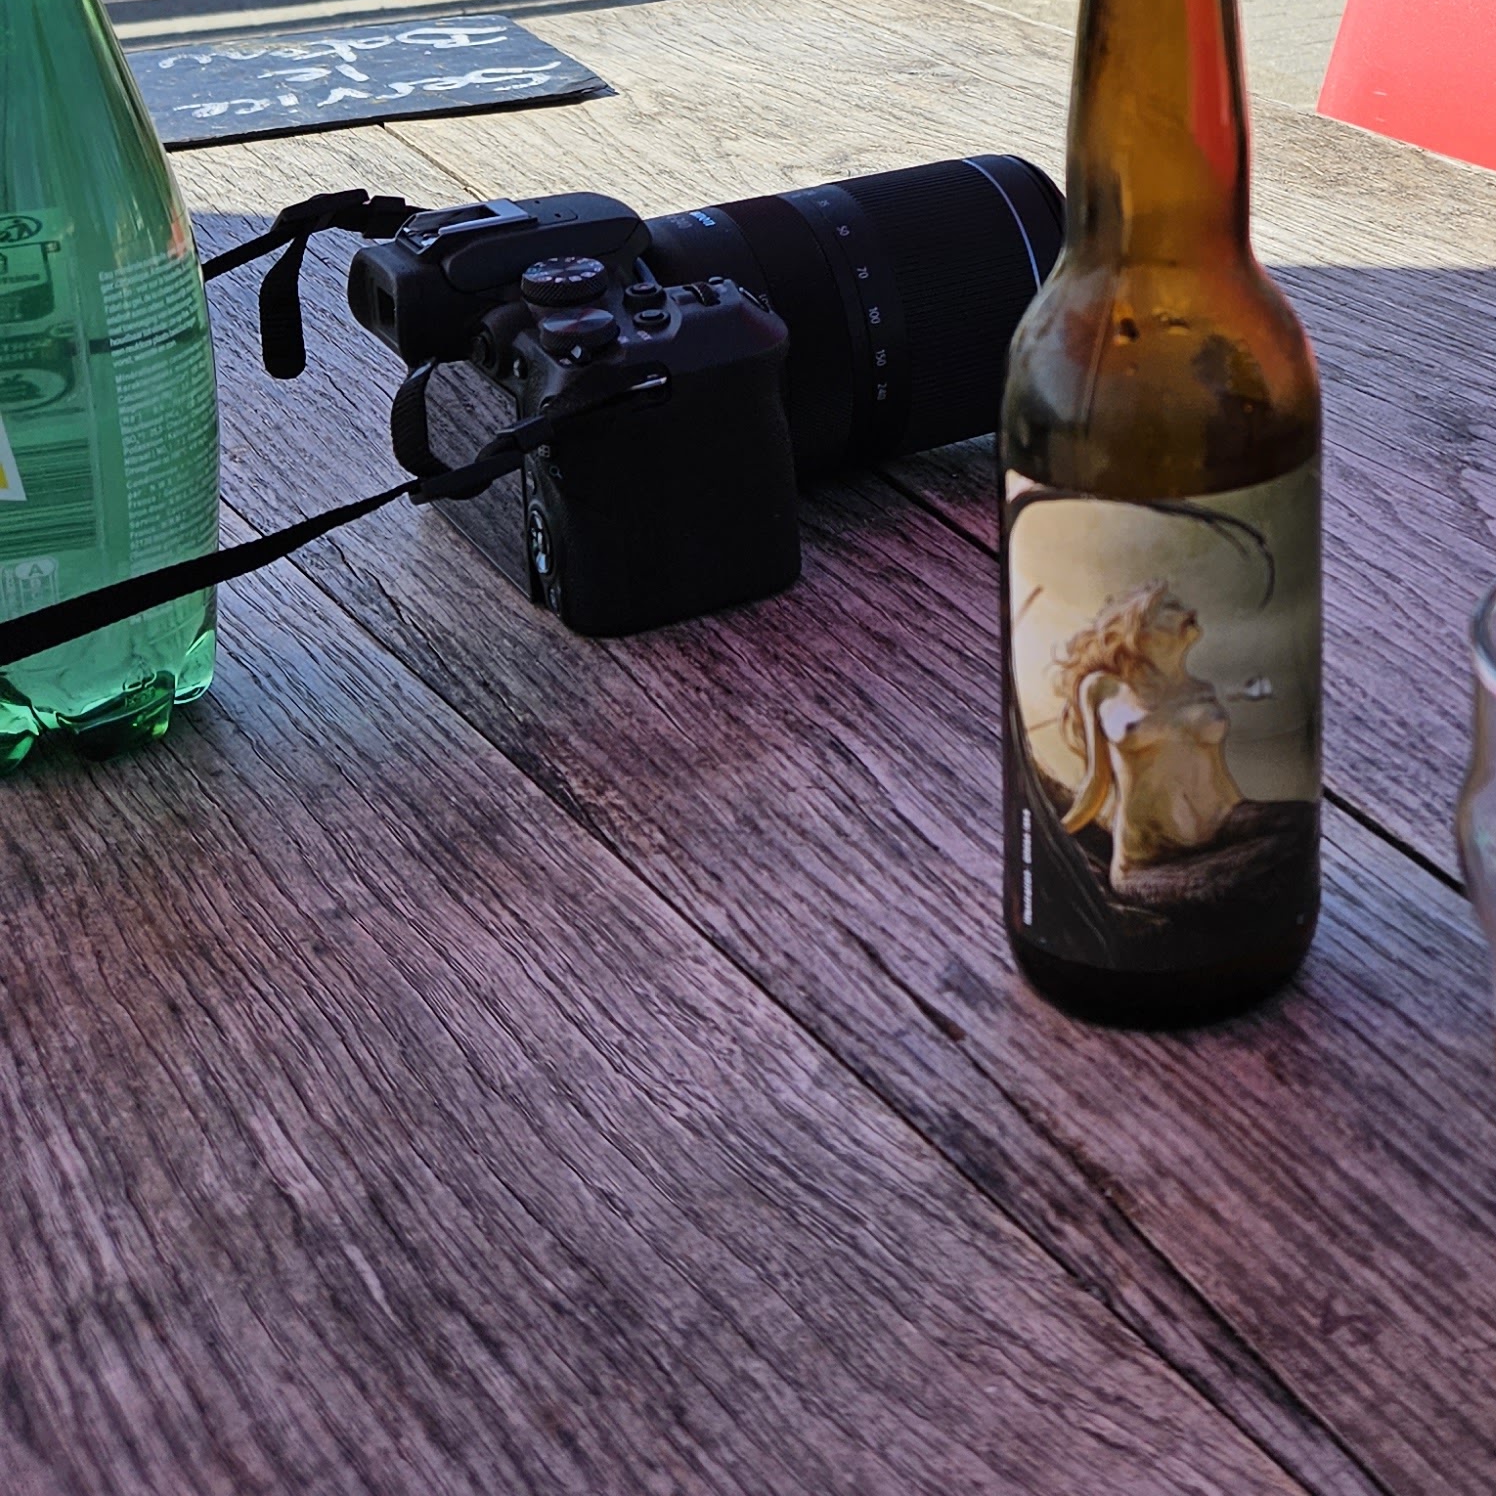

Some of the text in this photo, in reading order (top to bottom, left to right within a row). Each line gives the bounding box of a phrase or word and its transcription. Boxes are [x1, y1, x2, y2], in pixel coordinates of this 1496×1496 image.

[173, 61, 561, 118] Service
[856, 266, 869, 280] 70
[868, 306, 881, 325] 100
[875, 349, 887, 367] 150
